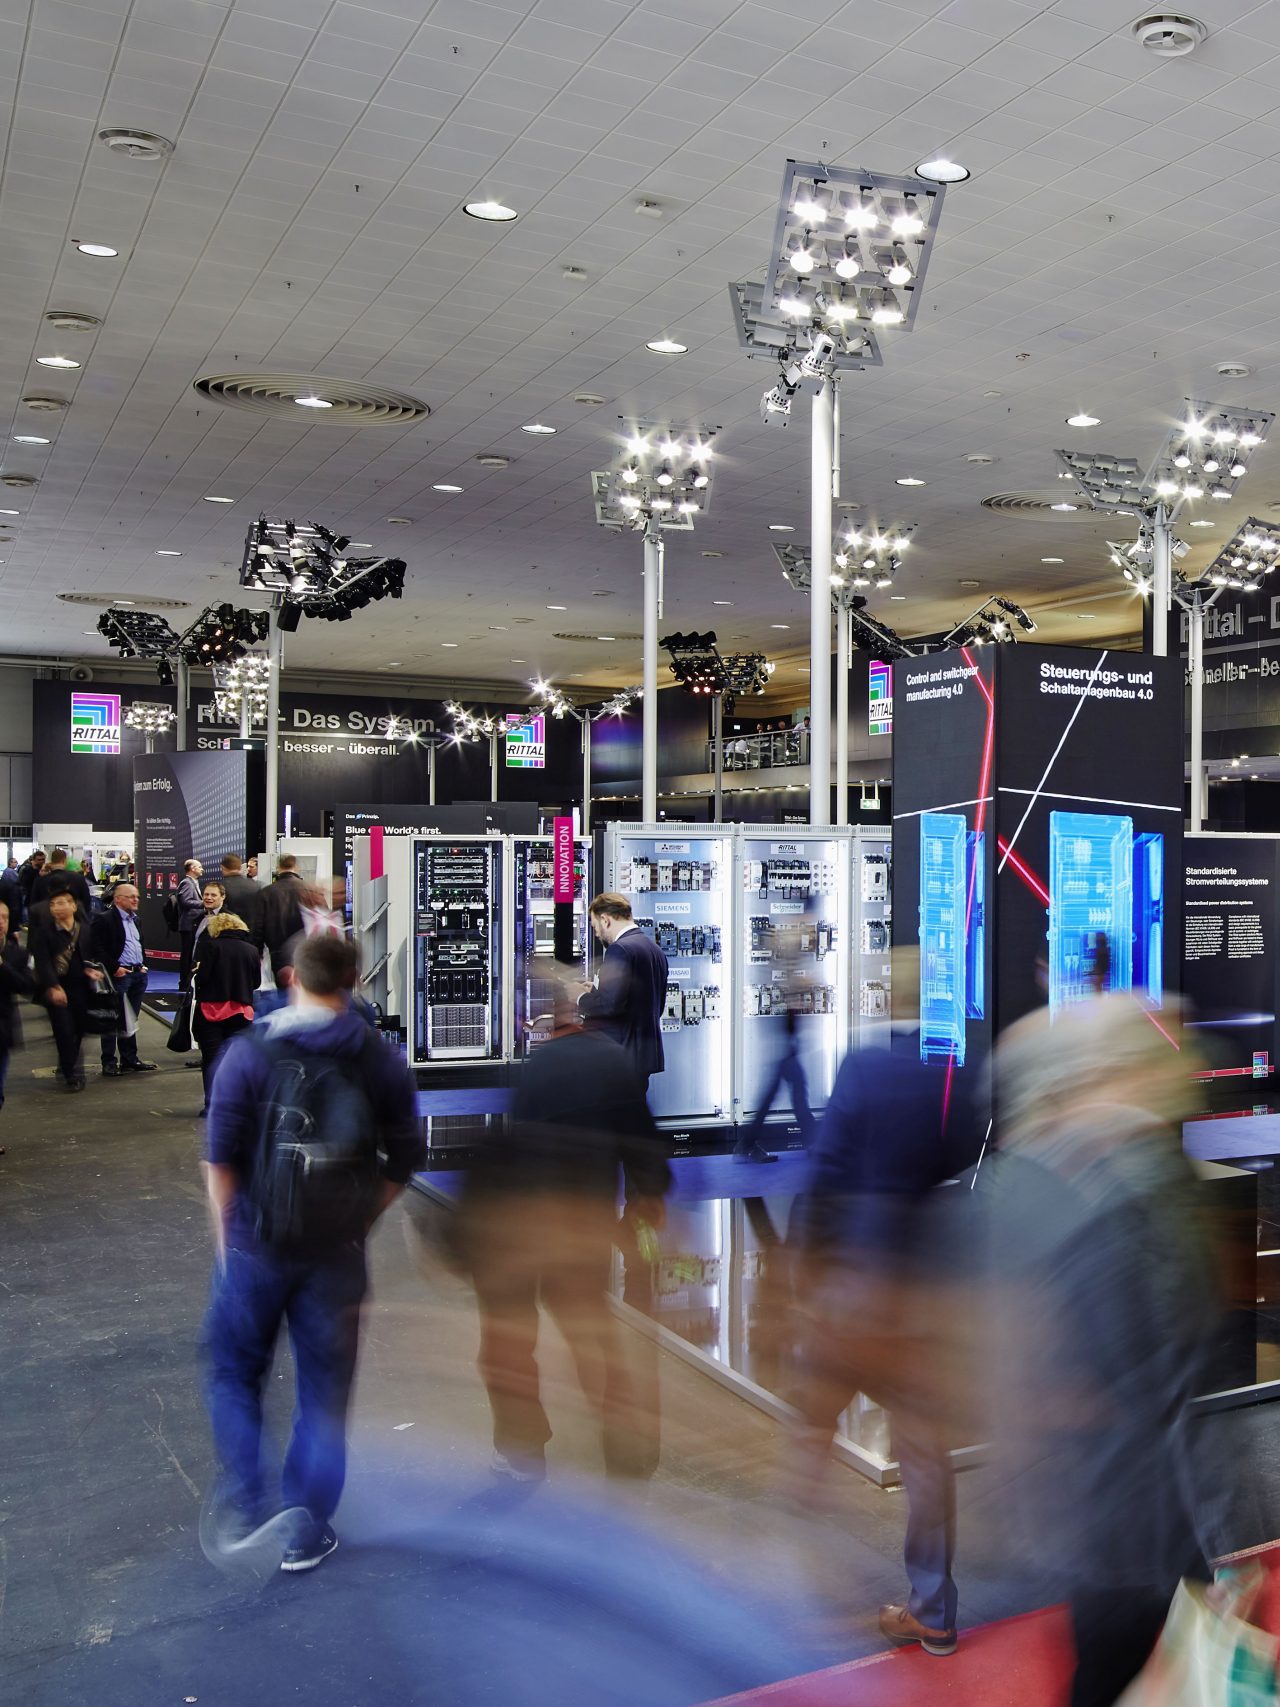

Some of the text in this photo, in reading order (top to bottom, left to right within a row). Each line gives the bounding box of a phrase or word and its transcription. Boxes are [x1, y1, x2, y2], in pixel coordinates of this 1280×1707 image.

[1180, 604, 1244, 643] Rttal
[906, 666, 979, 686] Control and switchgear
[1040, 662, 1153, 685] Steuerungs- und
[1185, 662, 1248, 685] Sneller
[906, 683, 963, 702] manufacturing 4.0
[1039, 681, 1154, 700] Schaltanlagenbau 4.0
[870, 702, 893, 718] RITTAL
[293, 708, 341, 729] Das
[347, 711, 440, 734] Sysem.
[72, 727, 120, 740] RITTAL
[284, 741, 335, 754] besser
[349, 743, 400, 756] überall.
[507, 744, 544, 756] RITTAL
[152, 778, 173, 792] Erfolg.
[345, 826, 366, 834] Blue
[384, 827, 419, 835] World's
[560, 825, 570, 893] INNOVATION
[1185, 867, 1238, 876] Standardisierte
[1185, 878, 1269, 887] Stromverteilungssysteme
